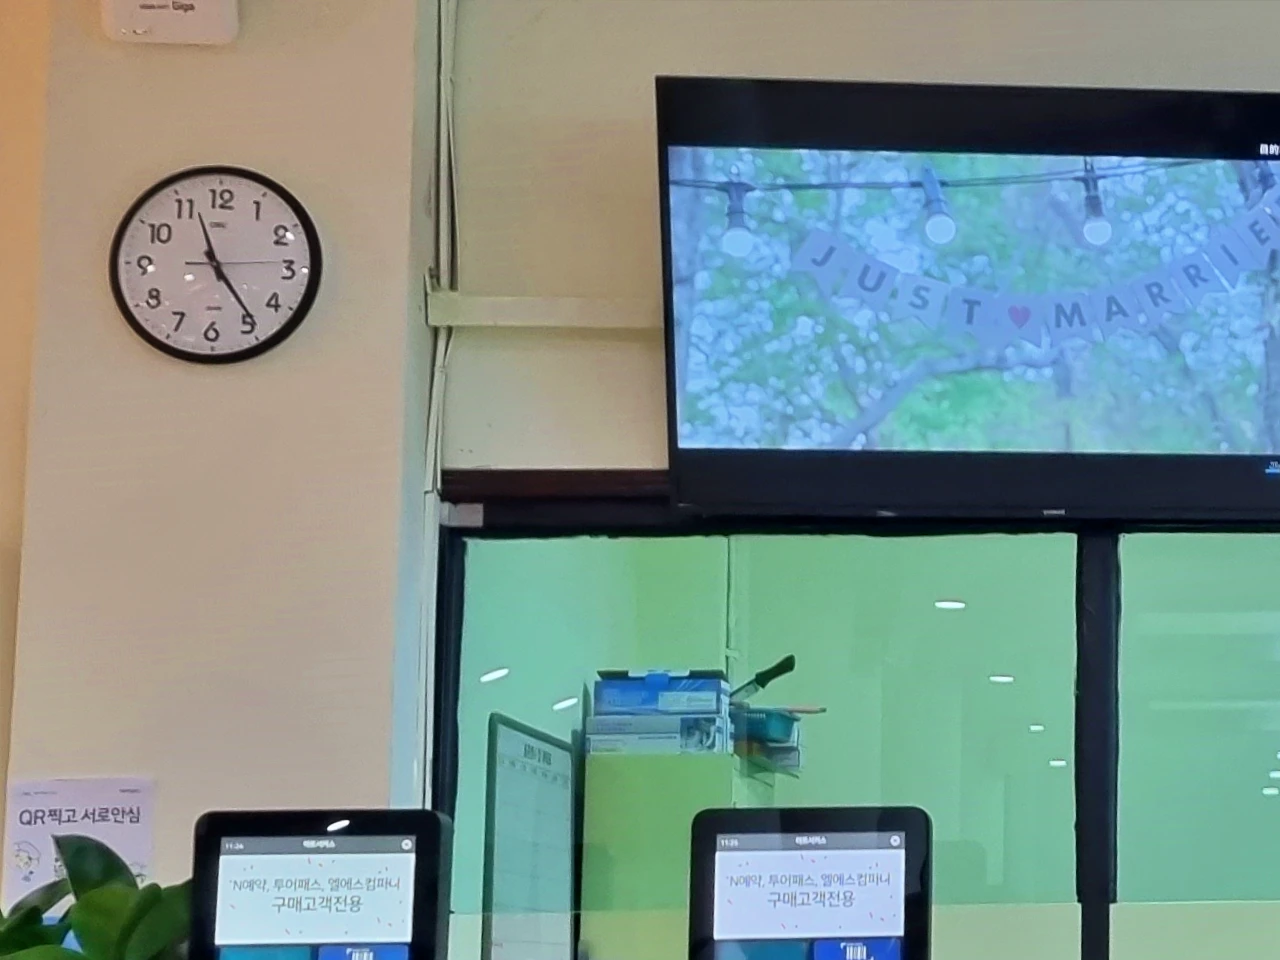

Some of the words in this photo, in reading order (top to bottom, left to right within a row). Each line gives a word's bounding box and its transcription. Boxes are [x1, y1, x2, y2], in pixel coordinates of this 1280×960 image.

[175, 198, 194, 219] 11
[208, 188, 235, 210] 12
[253, 200, 261, 221] 1
[149, 223, 172, 244] 10
[273, 224, 290, 246] 2
[137, 255, 154, 276] 9
[281, 259, 296, 280] 3
[811, 246, 981, 325] JUST
[146, 288, 161, 309] 8
[265, 292, 281, 313] 4
[172, 311, 186, 332] 7
[203, 321, 220, 342] 6
[240, 313, 257, 334] 5
[19, 807, 78, 826] QR찍고
[80, 806, 141, 825] 서로안심
[271, 895, 363, 913] 구매고객전용
[767, 890, 856, 908] 구매고객전용
